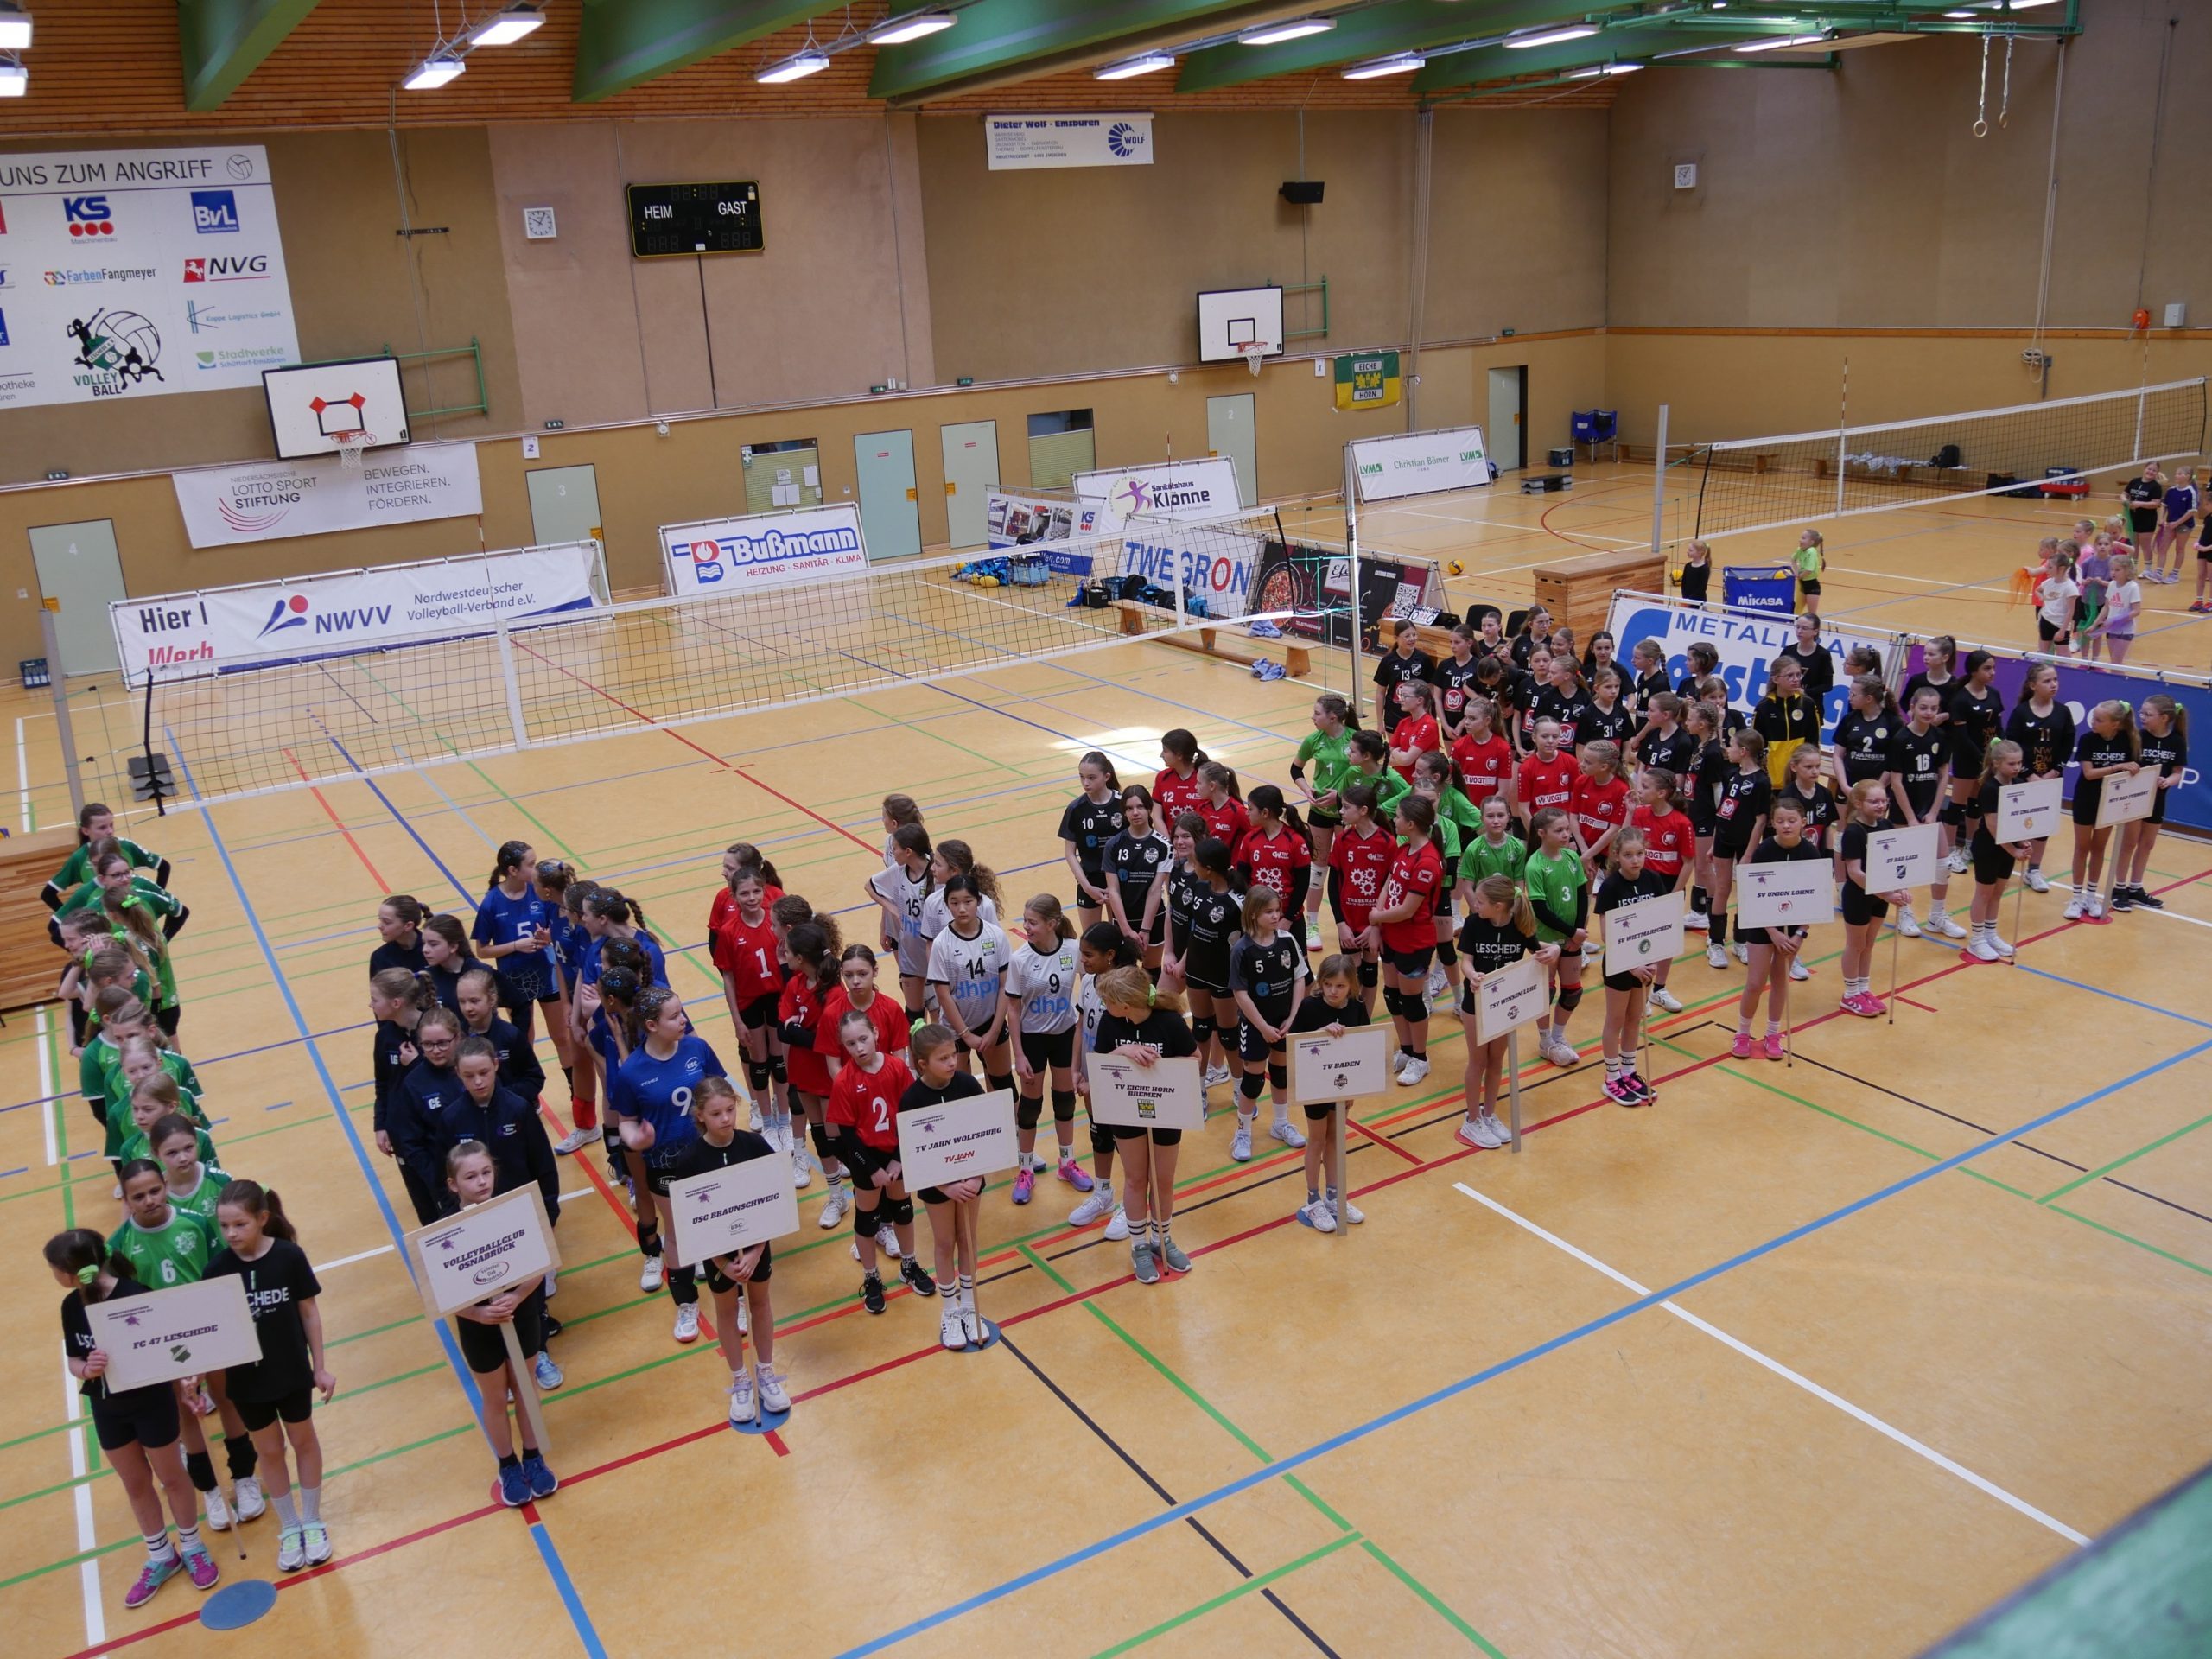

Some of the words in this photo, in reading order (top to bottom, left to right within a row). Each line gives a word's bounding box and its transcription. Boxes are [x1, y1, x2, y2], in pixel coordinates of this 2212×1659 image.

[994, 120, 1022, 129] Dieter
[1025, 119, 1047, 129] Wolf
[1124, 135, 1147, 144] WOLF
[54, 162, 106, 184] ZUM
[116, 159, 213, 181] ANGRIFF
[63, 195, 111, 221] KS
[194, 205, 238, 226] BvL
[645, 204, 673, 219] HEIM
[718, 200, 747, 215] GAST
[209, 255, 268, 275] NVG
[218, 346, 285, 360] Stadtwerke
[1358, 362, 1377, 372] EICHE
[73, 372, 118, 386] VOLLEY
[92, 385, 123, 397] BALL
[1359, 390, 1377, 399] HORN
[1393, 458, 1426, 470] Christian
[1427, 455, 1450, 467] Bömer
[364, 464, 430, 480] BEWEGEN.
[232, 481, 274, 496] LOTTO
[276, 476, 317, 491] SPORT
[366, 477, 451, 495] INTEGRIEREN.
[235, 492, 302, 509] STIFTUNG
[1154, 490, 1211, 508] Klönne
[1080, 511, 1096, 524] KS
[734, 528, 857, 564] Bußmann
[746, 563, 785, 577] HEIZUNG
[793, 556, 829, 570] SANITÄR
[836, 553, 862, 565] KLIMA
[414, 582, 524, 605] Nordwestdeutscher
[1738, 594, 1784, 606] MIKASA
[407, 596, 515, 621] Volleyball-Verband
[518, 593, 537, 607] e.V.
[139, 607, 192, 633] Hier
[315, 604, 392, 635] NWVV
[1402, 669, 1410, 681] 13
[1452, 675, 1461, 688] 12
[1531, 696, 1539, 708] 9
[1562, 709, 1569, 721] 2
[1604, 726, 1613, 738] 31
[1862, 736, 1873, 753] 2
[1650, 752, 1658, 765] 8
[1915, 753, 1931, 772] 16
[1326, 762, 1334, 776] 1
[1162, 791, 1174, 803] 12
[1730, 783, 1738, 798] 6
[1082, 817, 1094, 830] 10
[1118, 849, 1129, 861] 13
[1254, 849, 1260, 861] 6
[1347, 850, 1354, 863] 5
[1562, 886, 1571, 902] 3
[906, 897, 921, 918] 15
[517, 920, 534, 938] 5
[1475, 943, 1522, 954] LESCHEDE
[755, 947, 772, 979] 1
[965, 957, 986, 980] 14
[1255, 960, 1264, 974] 5
[1049, 973, 1060, 994] 9
[1489, 1001, 1501, 1010] TSV
[1087, 1008, 1095, 1030] 6
[687, 1060, 698, 1069] USC
[1334, 1060, 1361, 1069] BADEN
[671, 1086, 693, 1117] 9
[872, 1096, 889, 1132] 2
[928, 1139, 951, 1150] JAHN
[953, 1127, 1002, 1144] WOLFSBURG
[692, 1214, 709, 1224] USC
[710, 1192, 779, 1219] BRAUNSCHWEIG
[730, 1222, 743, 1230] USC
[442, 1229, 525, 1269] VOLLEYBALLCLUB
[161, 1258, 176, 1284] 6
[133, 1339, 147, 1350] FC
[149, 1337, 162, 1346] 47
[163, 1324, 219, 1343] LESCHEDE
